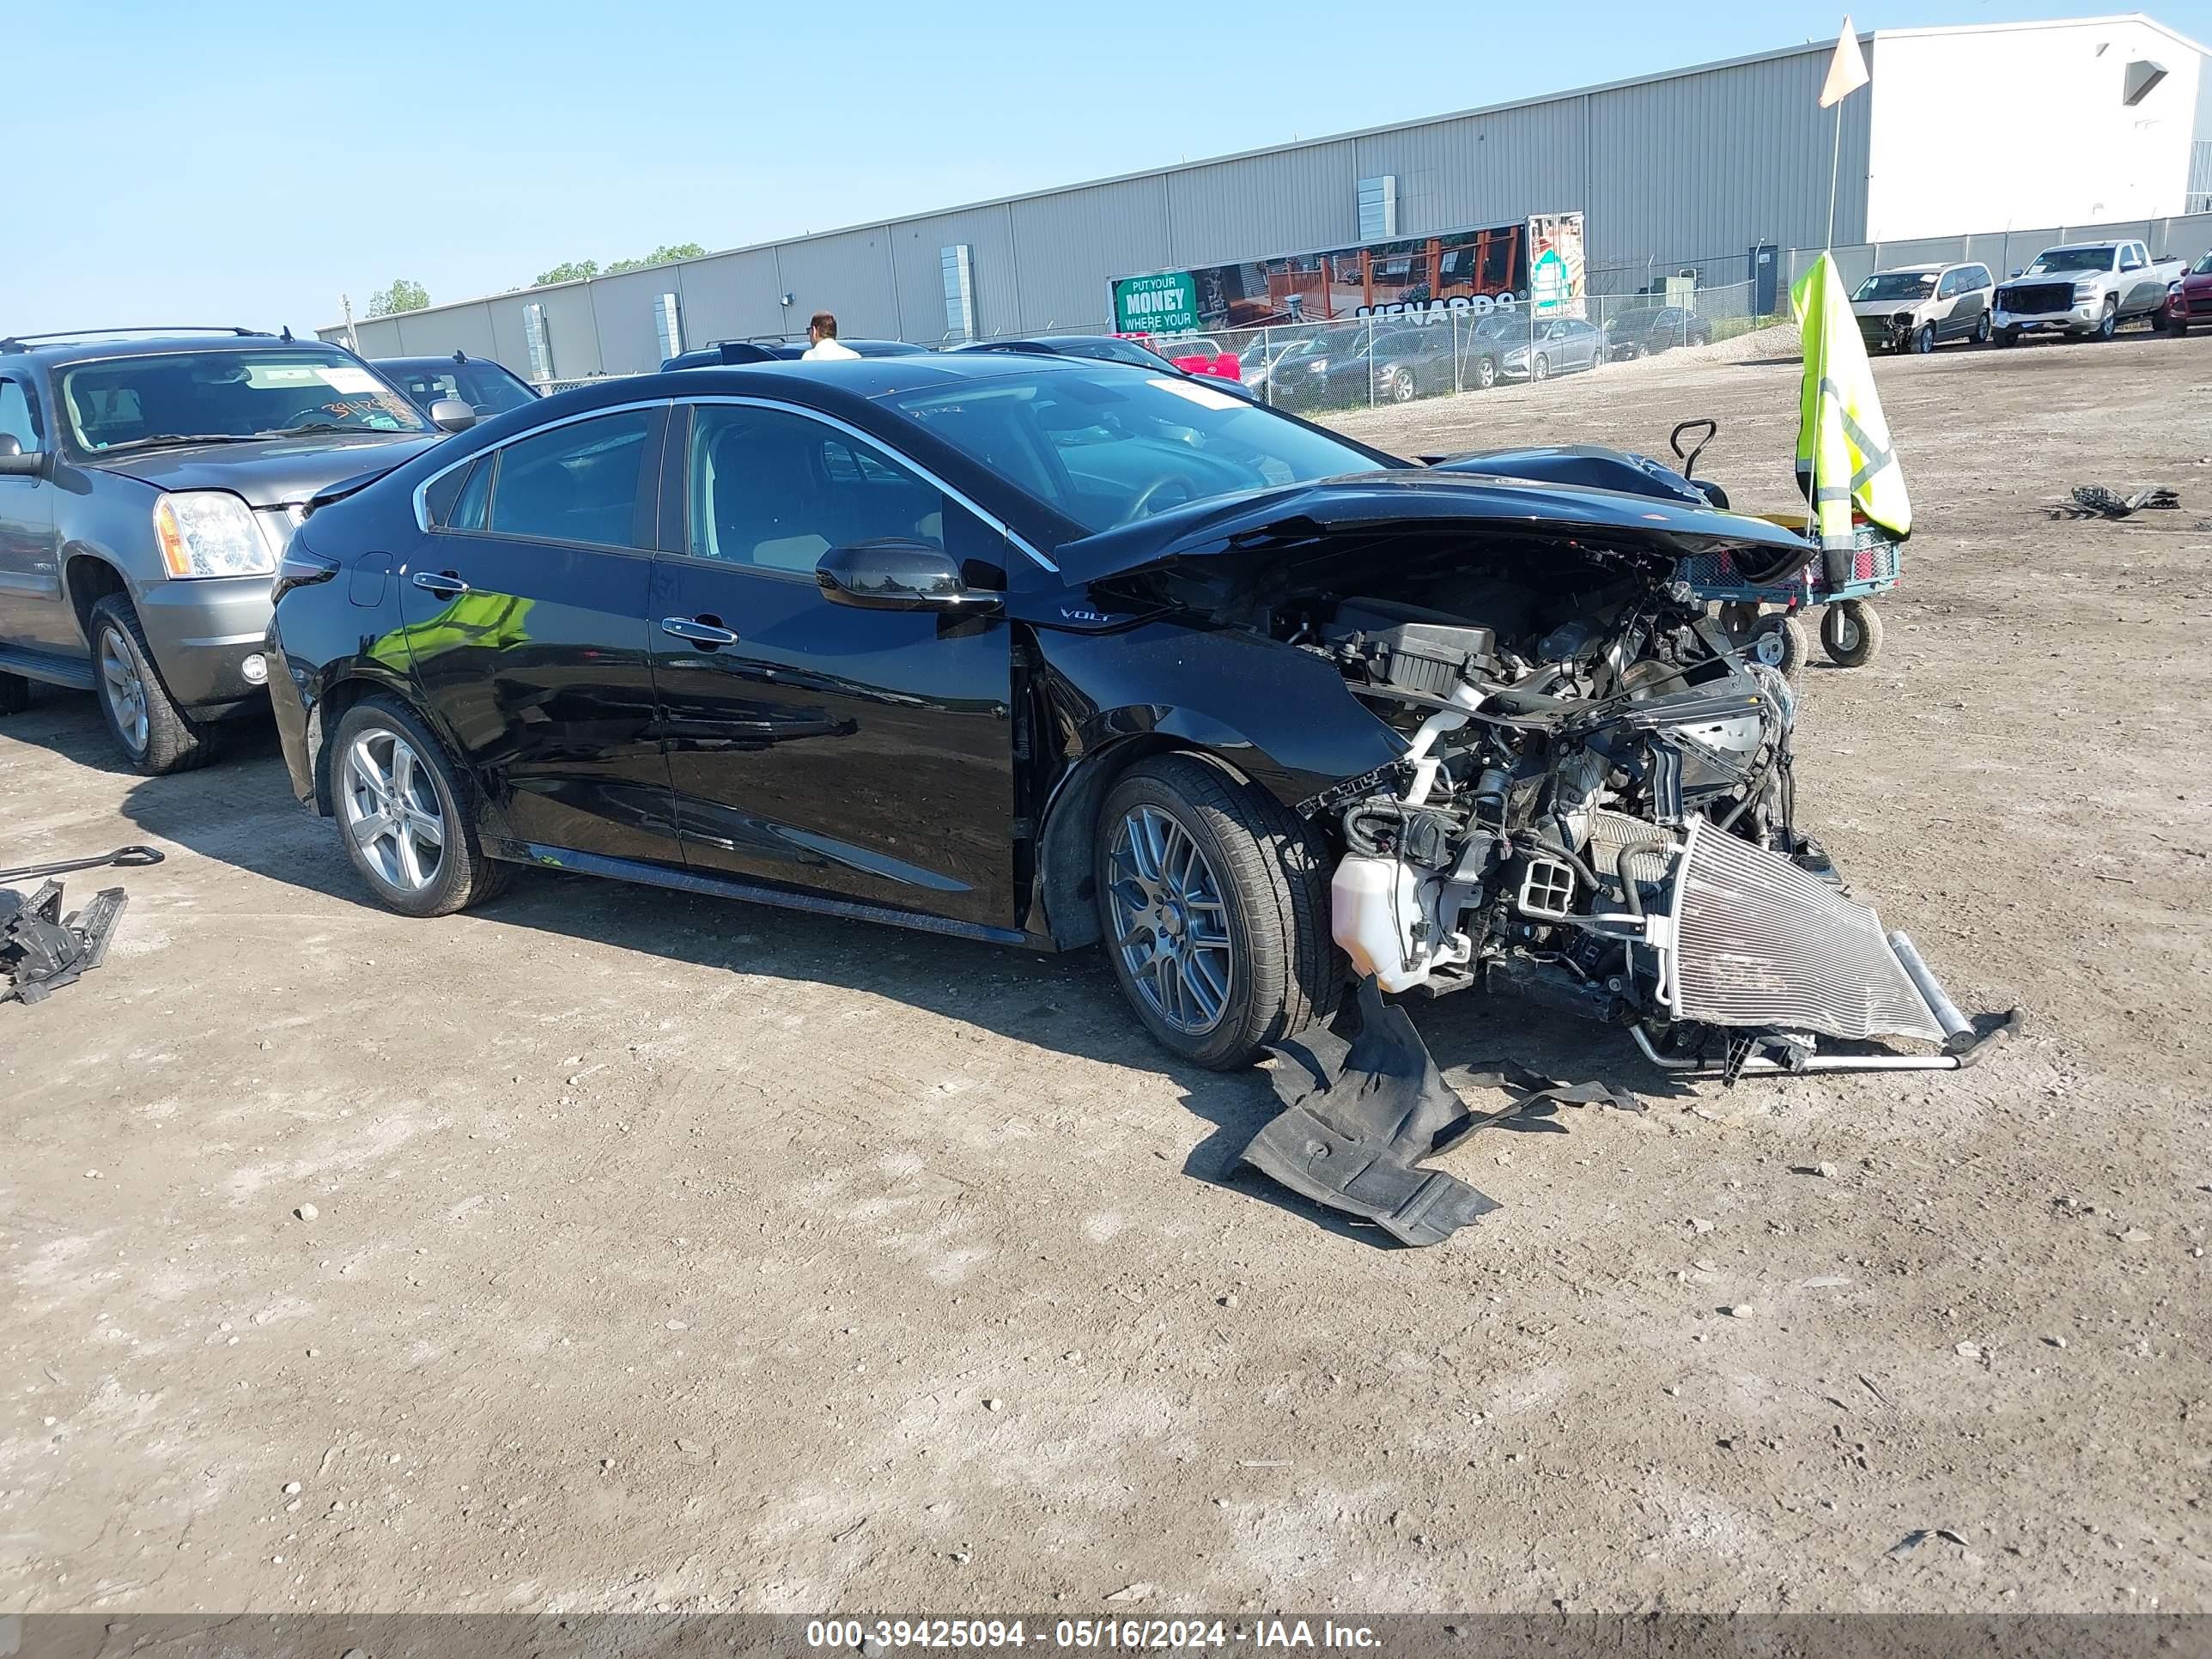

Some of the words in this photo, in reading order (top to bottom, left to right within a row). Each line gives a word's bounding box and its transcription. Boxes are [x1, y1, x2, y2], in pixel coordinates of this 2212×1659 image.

[1133, 280, 1149, 291] PUT
[1150, 277, 1176, 289] YOUR
[1126, 289, 1184, 315] MONEY
[1356, 291, 1516, 325] MENARDS
[1126, 316, 1162, 331] WHERE
[1164, 313, 1191, 326] YOUR
[1060, 606, 1113, 622] VOLT
